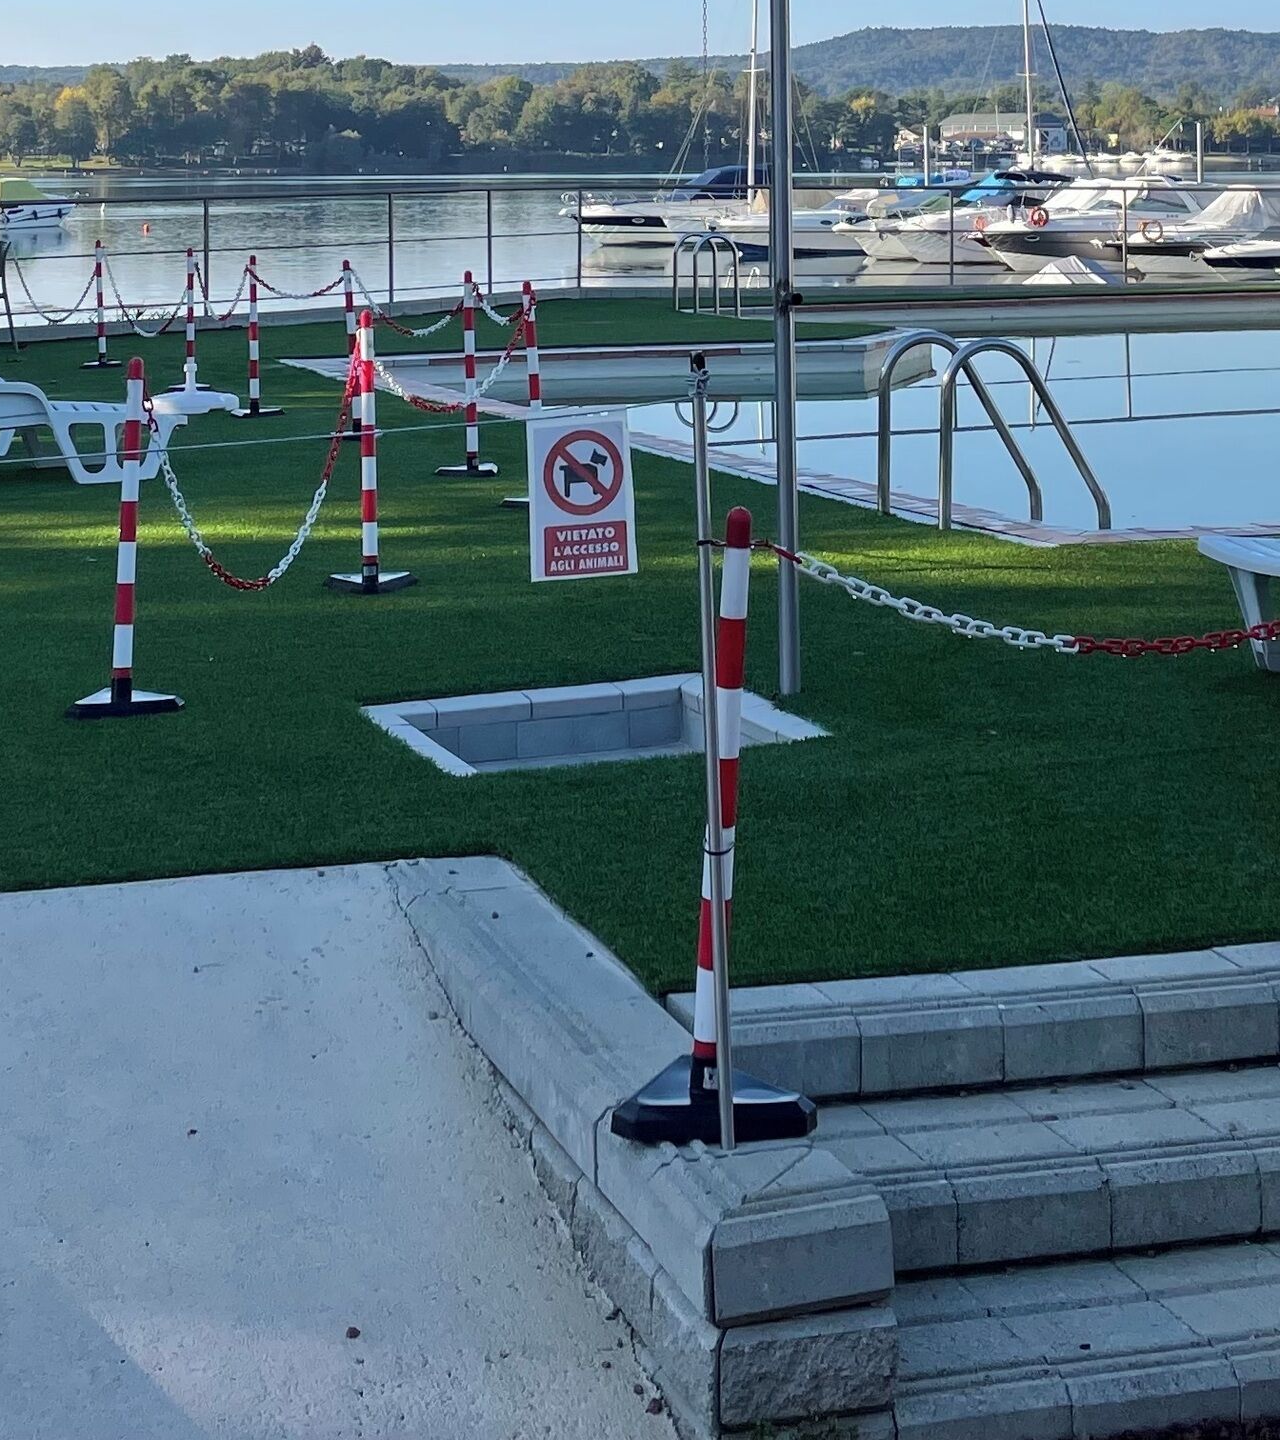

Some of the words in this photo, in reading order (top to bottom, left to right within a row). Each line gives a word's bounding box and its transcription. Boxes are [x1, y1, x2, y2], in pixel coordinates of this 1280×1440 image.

[556, 526, 615, 542] VIETATO
[554, 542, 619, 556] L'ACCESSO
[550, 559, 575, 572] AGLI
[579, 555, 624, 570] ANIMALI
